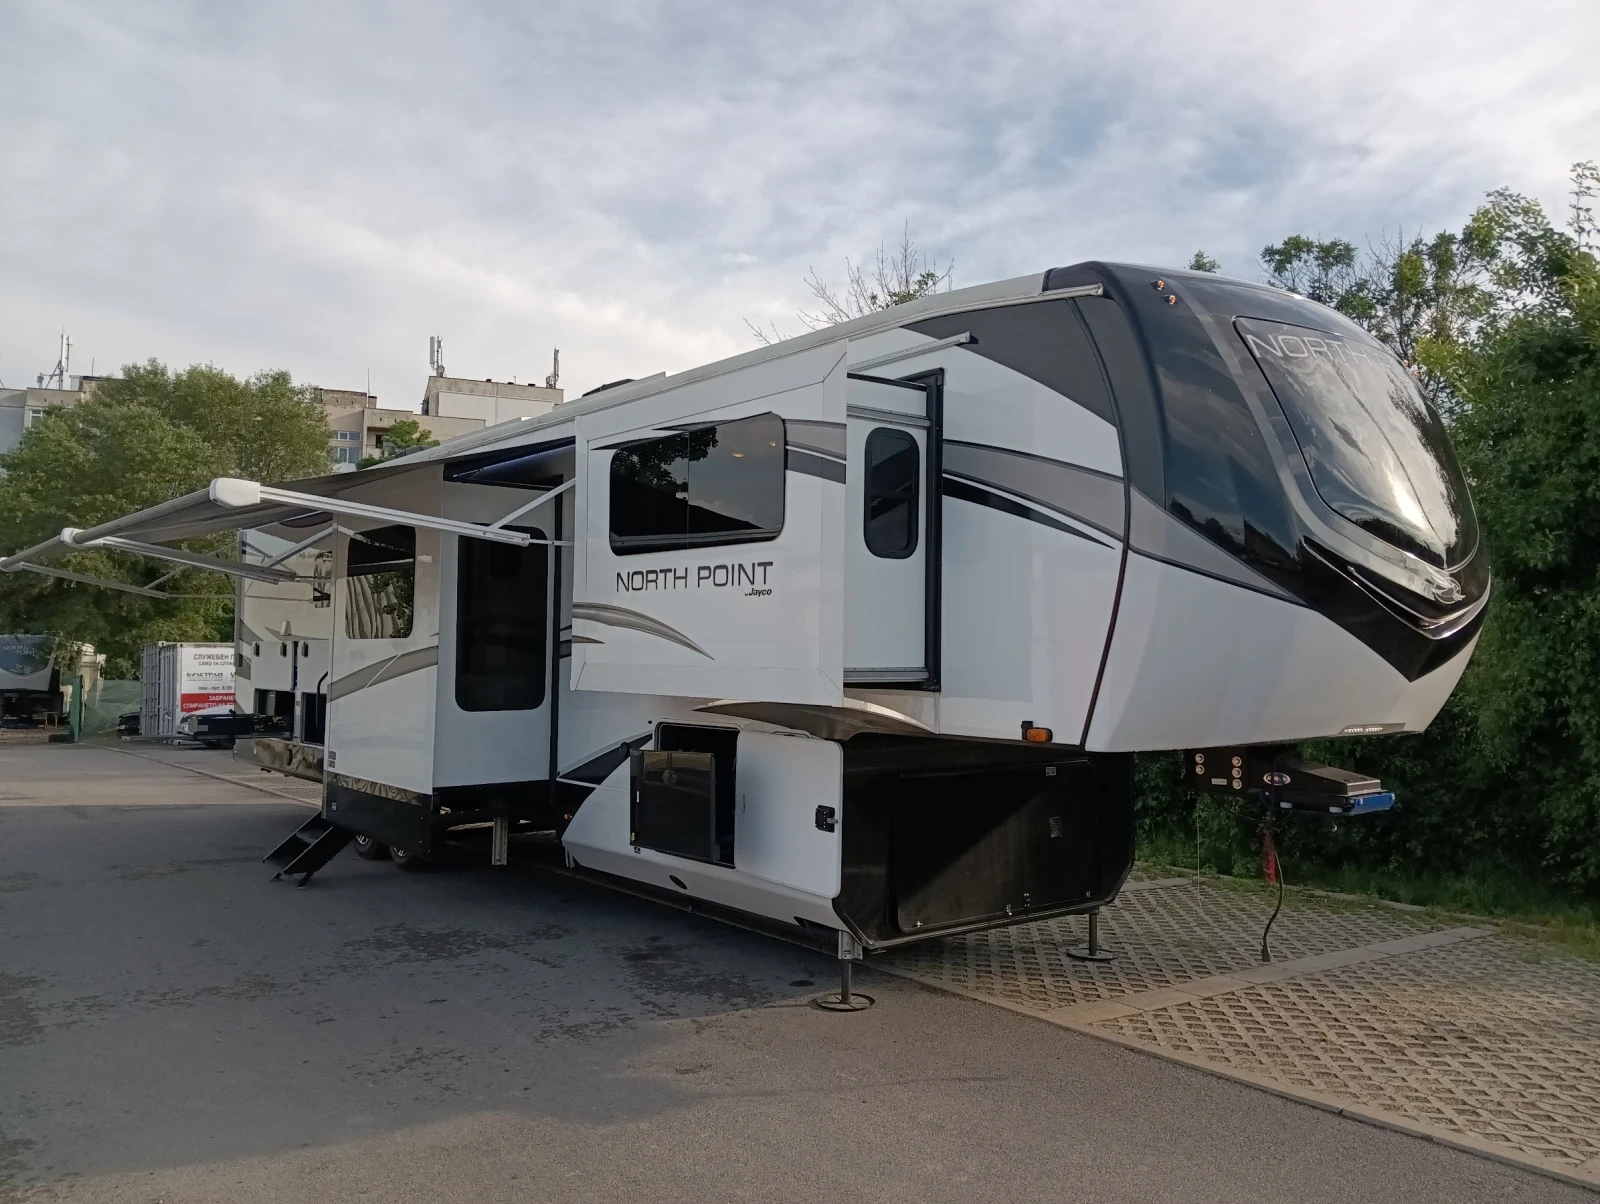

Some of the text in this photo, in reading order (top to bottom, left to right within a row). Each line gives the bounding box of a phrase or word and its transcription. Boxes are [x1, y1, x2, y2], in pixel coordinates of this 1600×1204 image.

[1245, 333, 1372, 368] NORTH
[616, 561, 774, 592] NORTH POINT
[748, 587, 773, 598] Jayco
